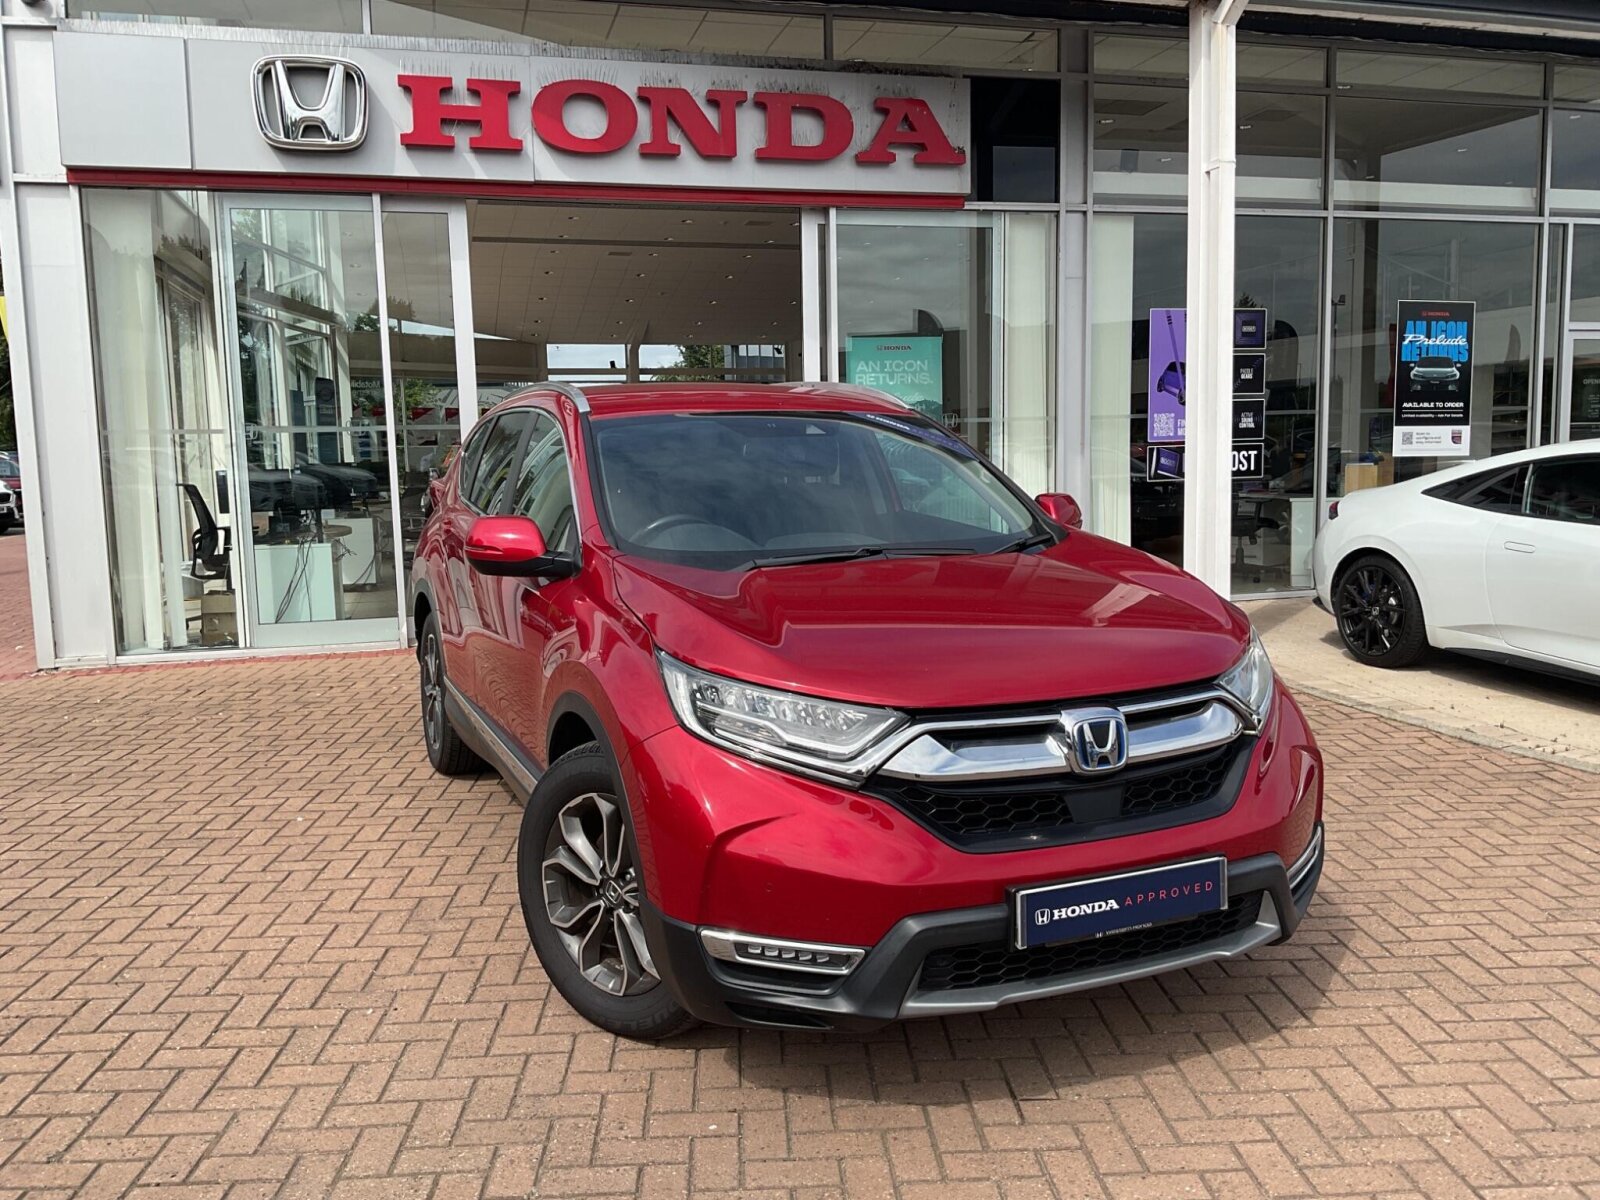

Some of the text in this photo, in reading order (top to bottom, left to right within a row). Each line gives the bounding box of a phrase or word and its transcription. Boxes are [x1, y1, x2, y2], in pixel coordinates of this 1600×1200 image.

[397, 74, 967, 165] HONDA
[1405, 320, 1468, 340] AN ICON
[1402, 333, 1468, 345] Prelude
[856, 359, 929, 373] AN ICON
[855, 372, 934, 386] RETURNS.
[1052, 881, 1213, 921] HONDA APPROVED
